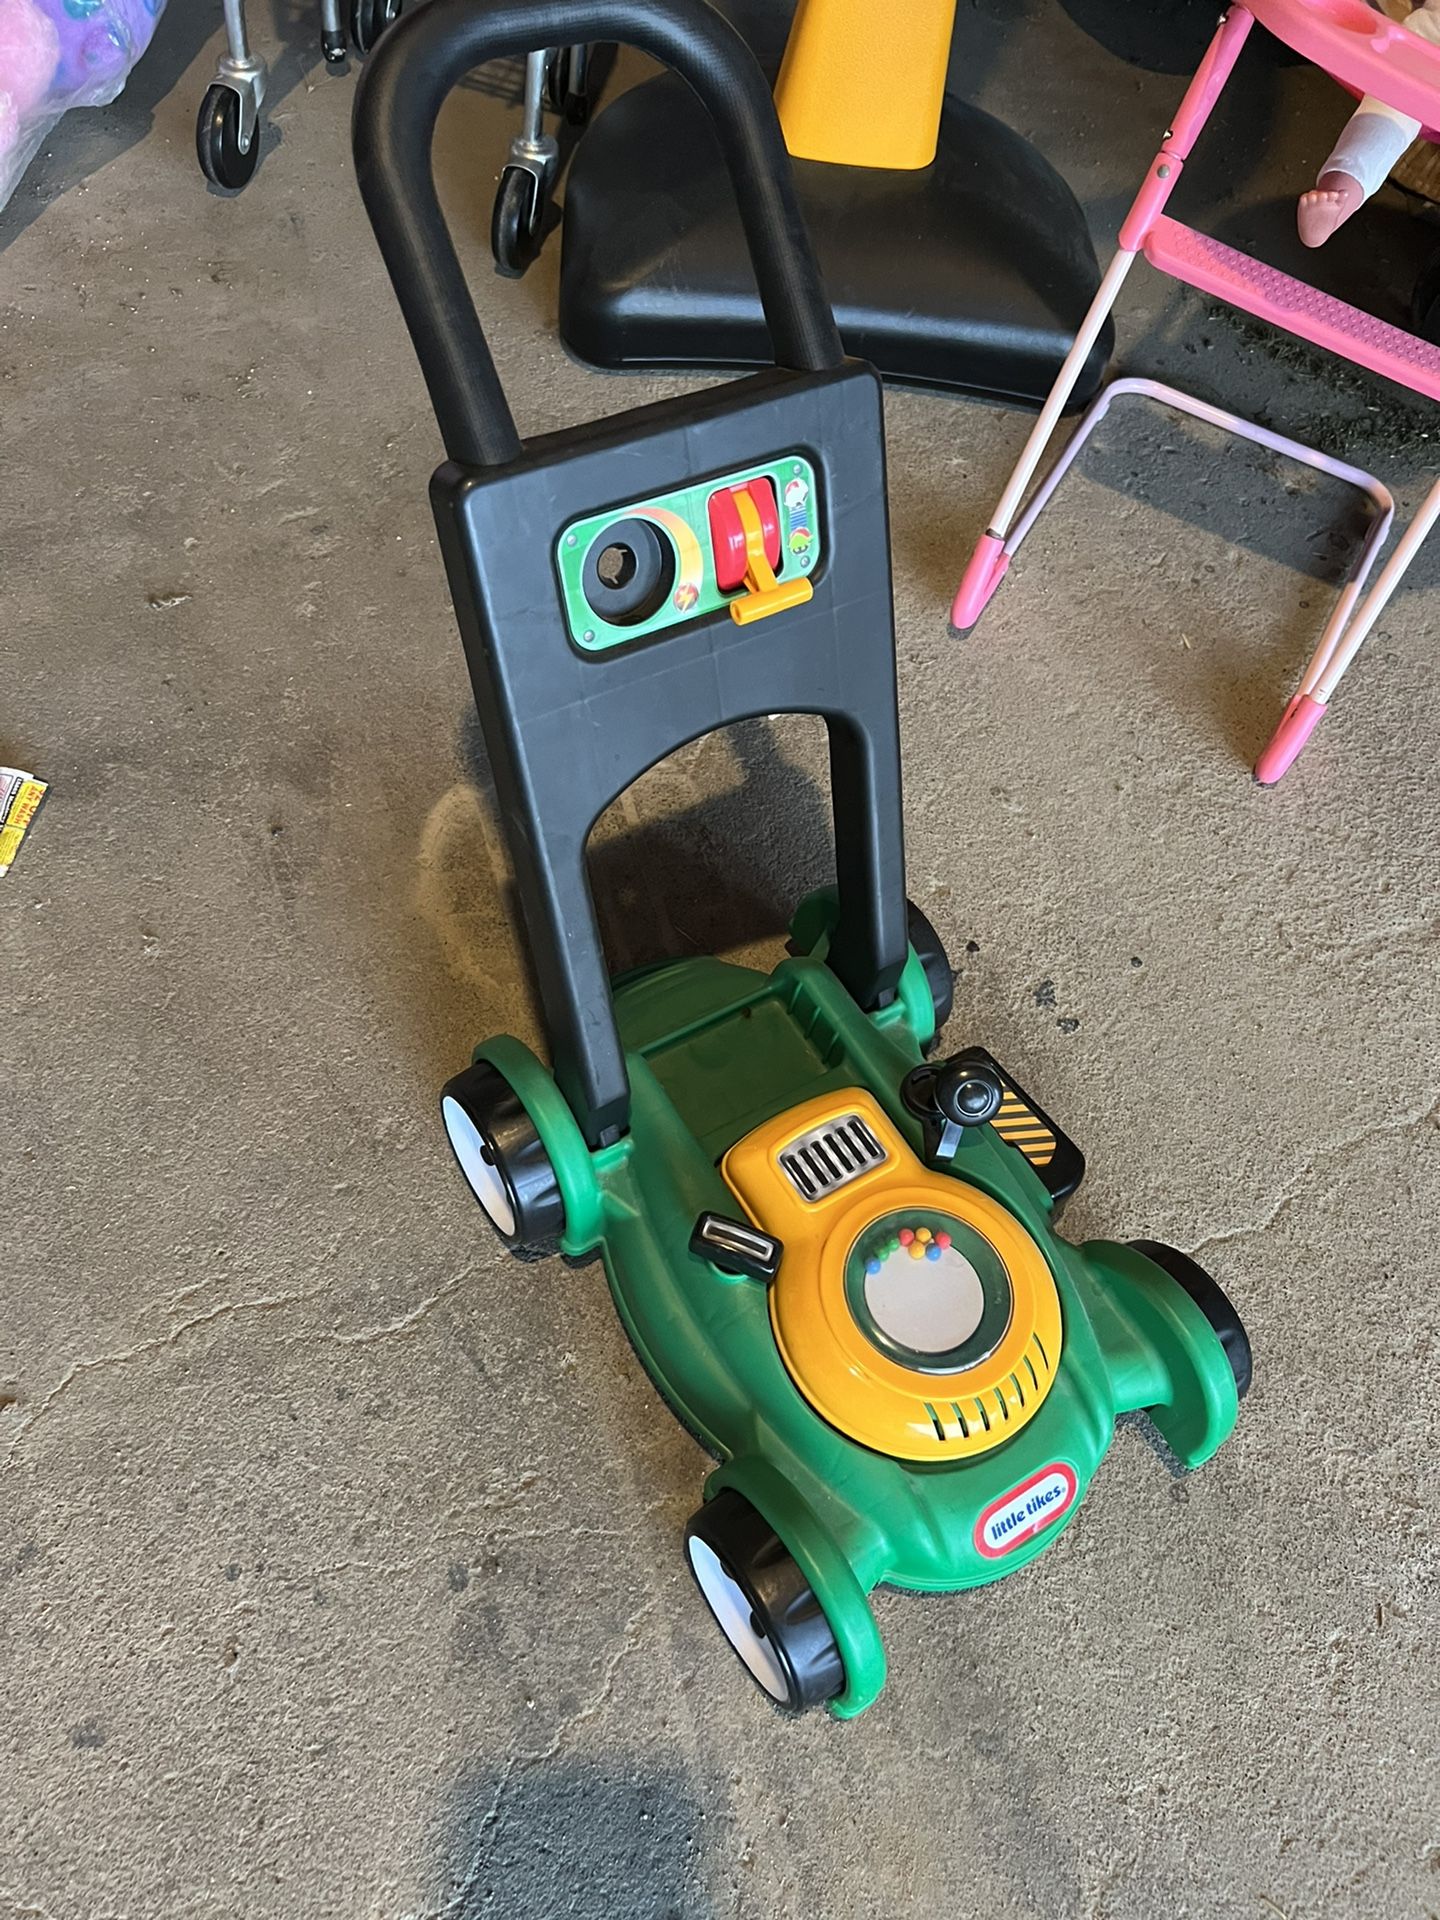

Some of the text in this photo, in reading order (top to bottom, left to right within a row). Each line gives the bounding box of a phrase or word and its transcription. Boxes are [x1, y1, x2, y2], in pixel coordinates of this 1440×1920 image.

[13, 804, 29, 824] WASH
[991, 1485, 1062, 1540] little tikes
